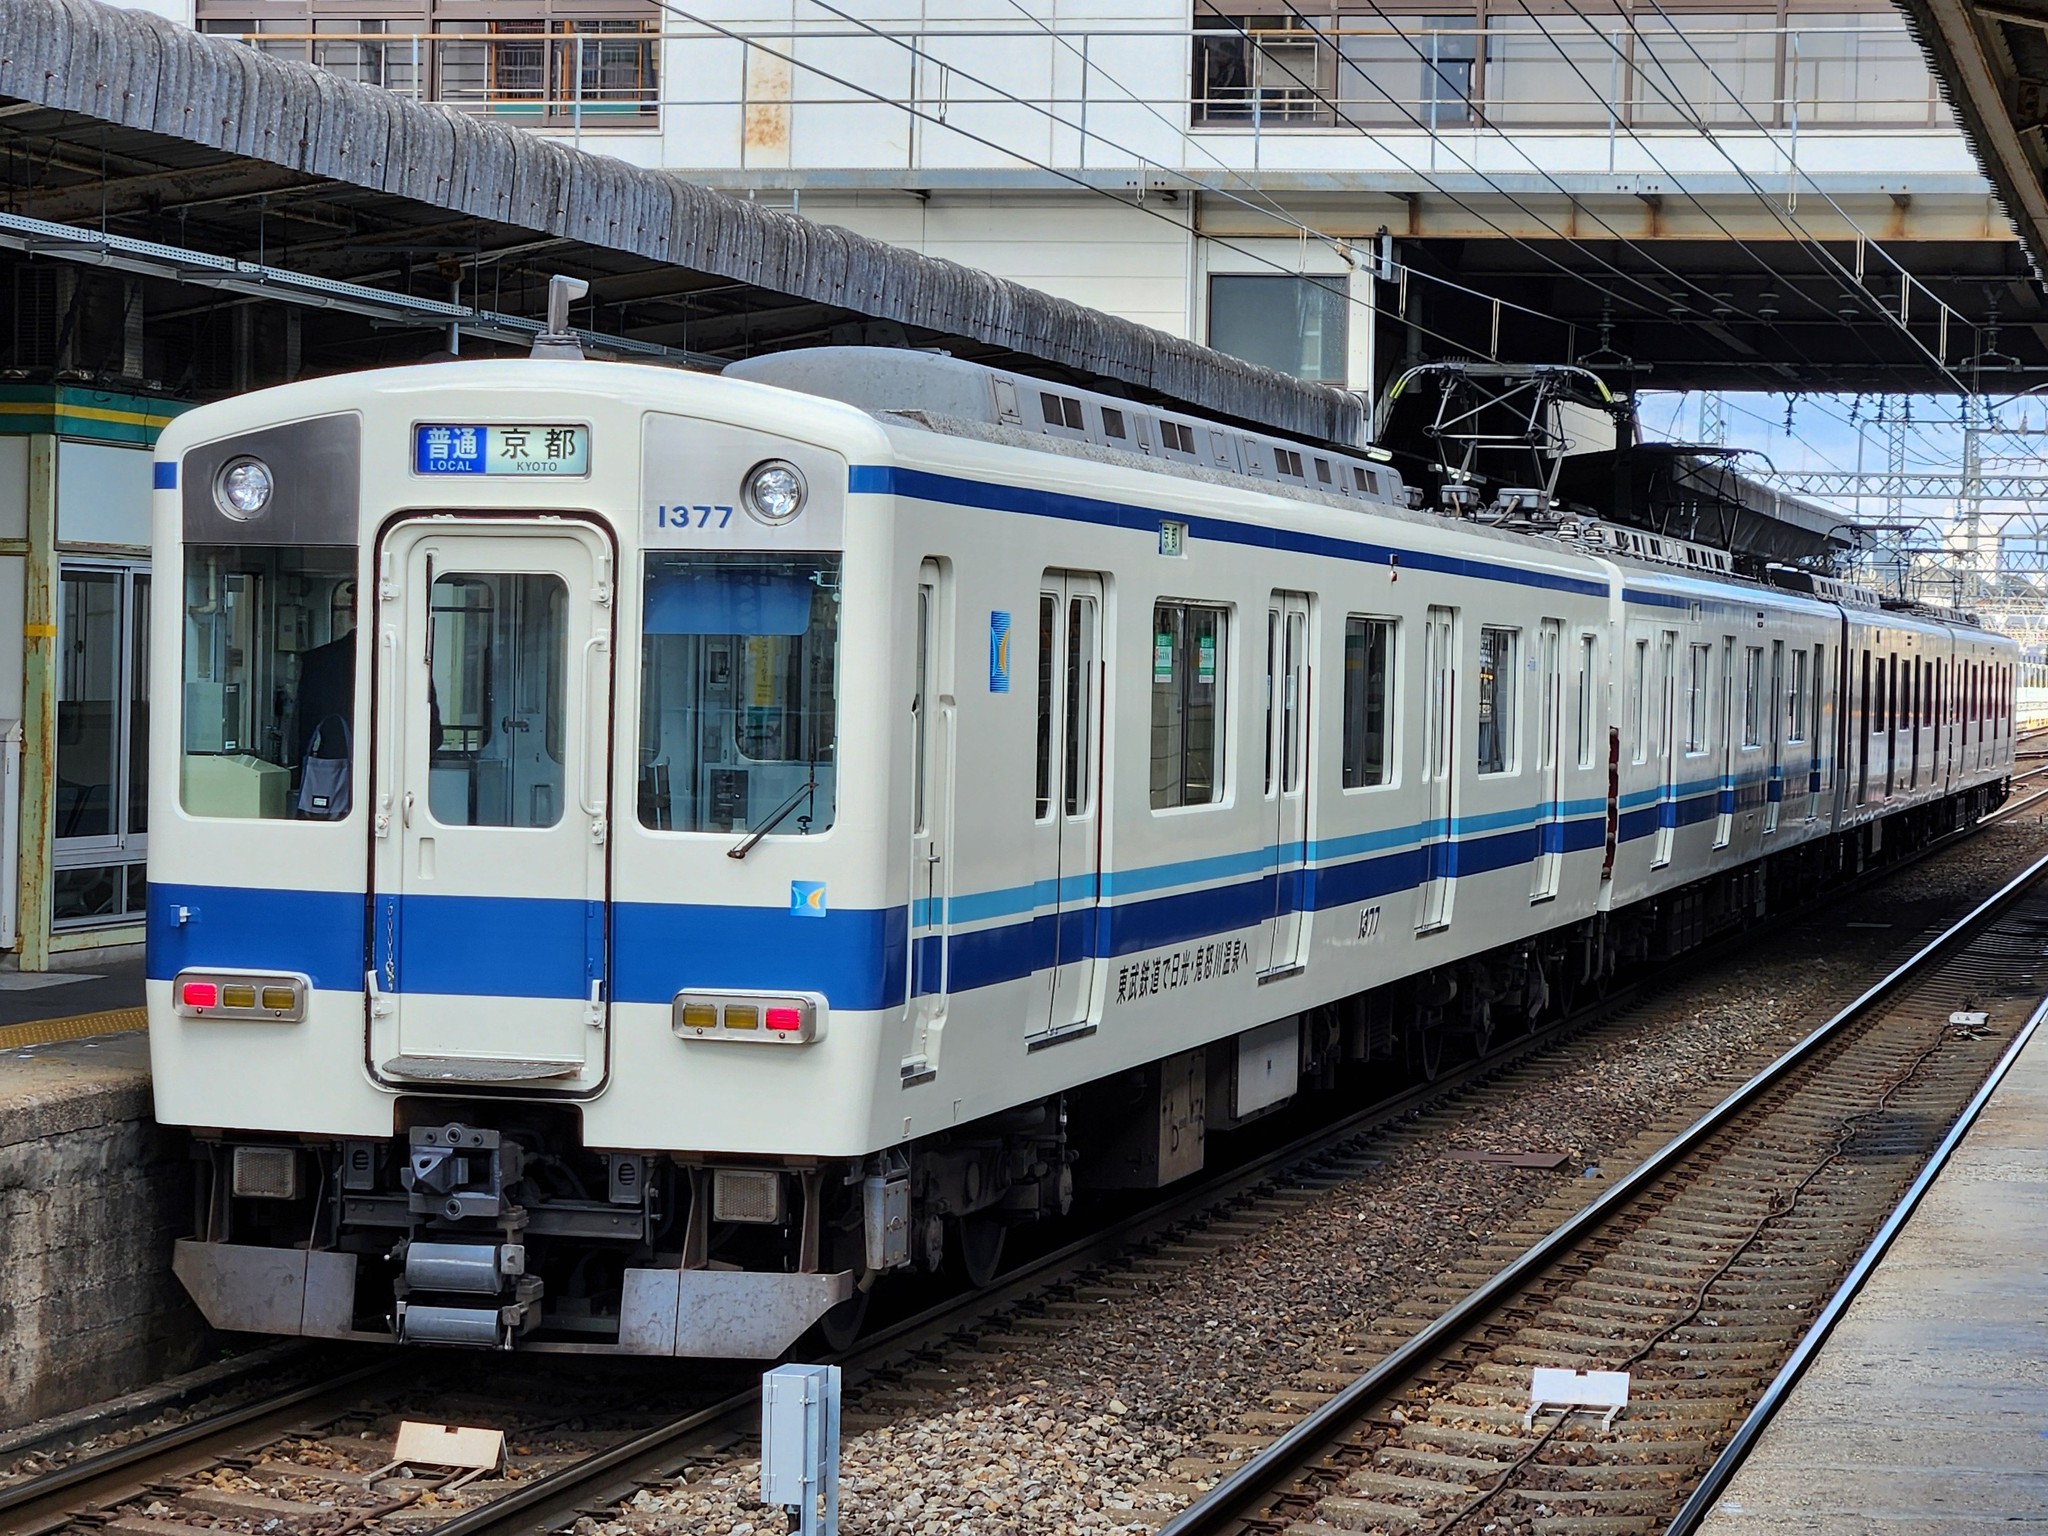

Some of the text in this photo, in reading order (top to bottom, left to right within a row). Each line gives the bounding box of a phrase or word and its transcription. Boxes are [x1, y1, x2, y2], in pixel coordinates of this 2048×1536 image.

[427, 427, 576, 460] 普通 京都
[430, 460, 557, 472] LOCAL KYOTO
[658, 504, 734, 529] 1377
[1357, 905, 1381, 939] 1377
